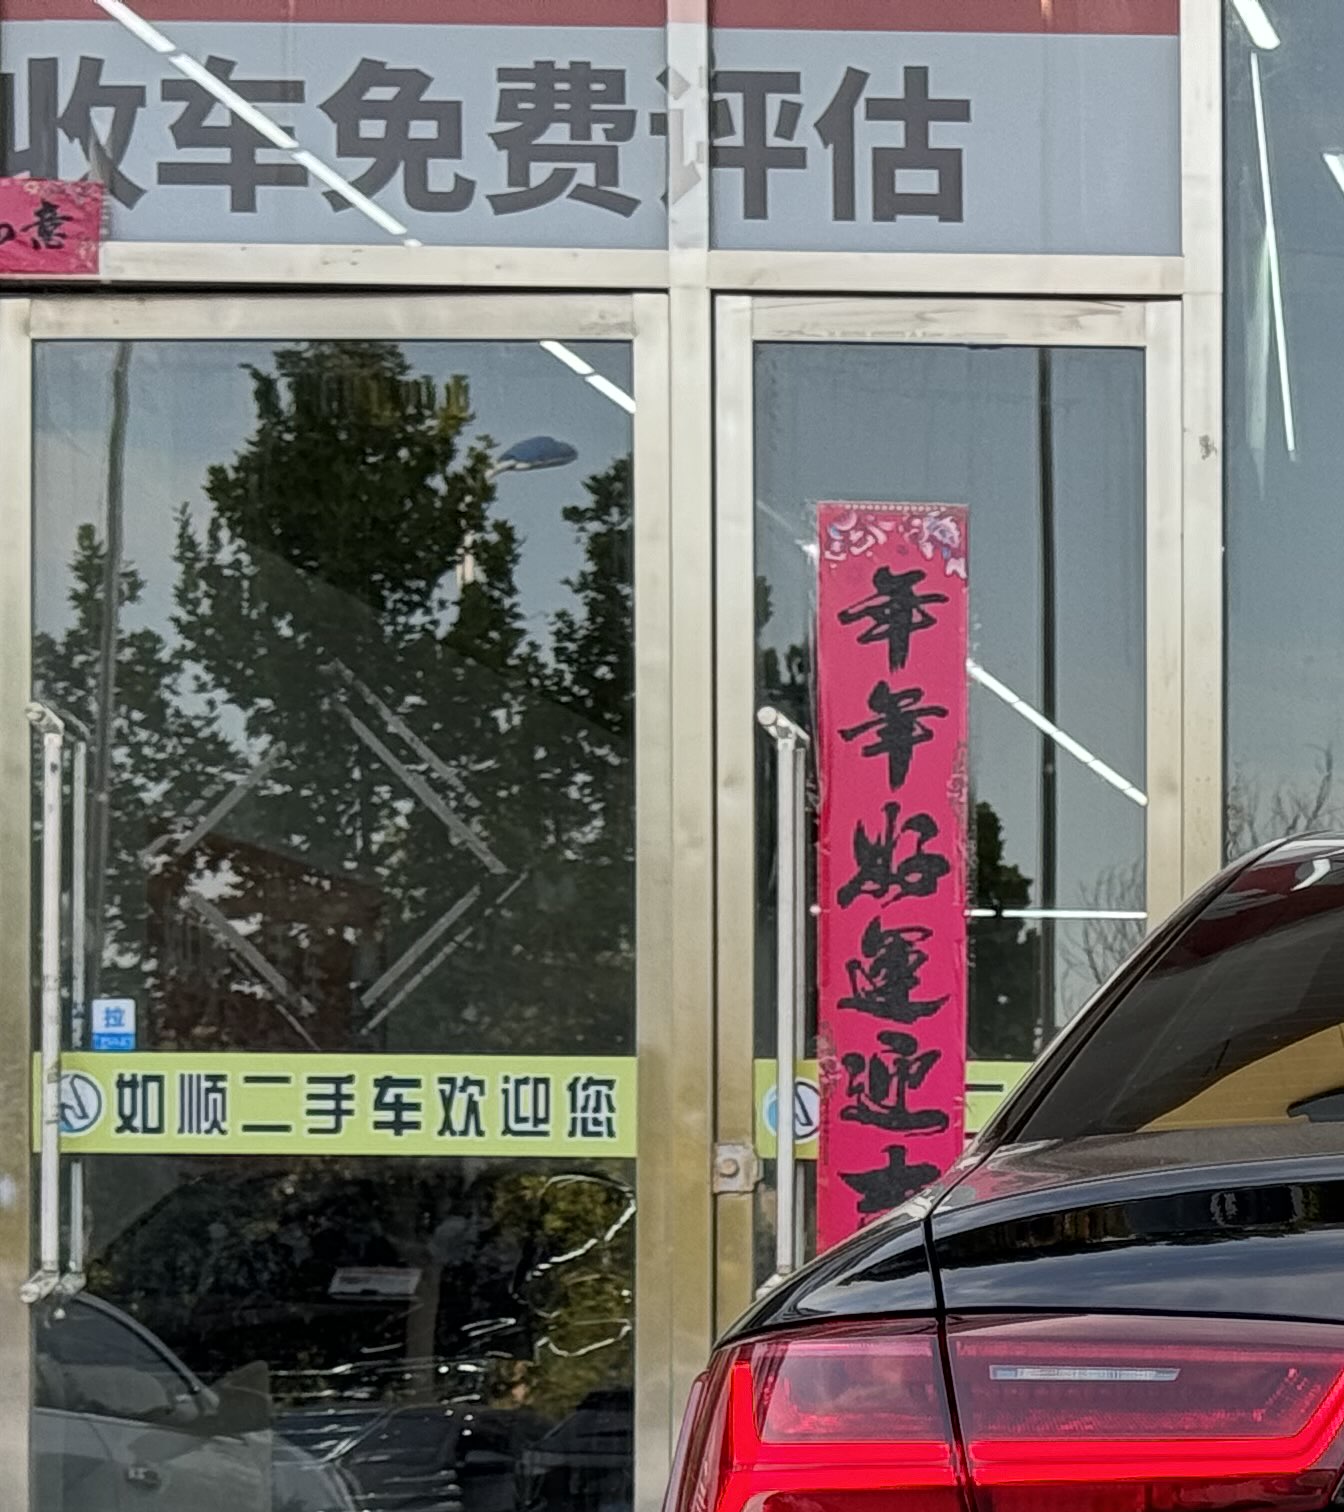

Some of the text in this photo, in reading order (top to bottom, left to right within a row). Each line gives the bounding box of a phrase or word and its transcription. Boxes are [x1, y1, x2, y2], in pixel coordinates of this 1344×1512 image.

[0, 55, 972, 224] 收车免费评估
[0, 199, 74, 250] 意
[114, 1072, 618, 1138] 如顺二手车欢迎您
